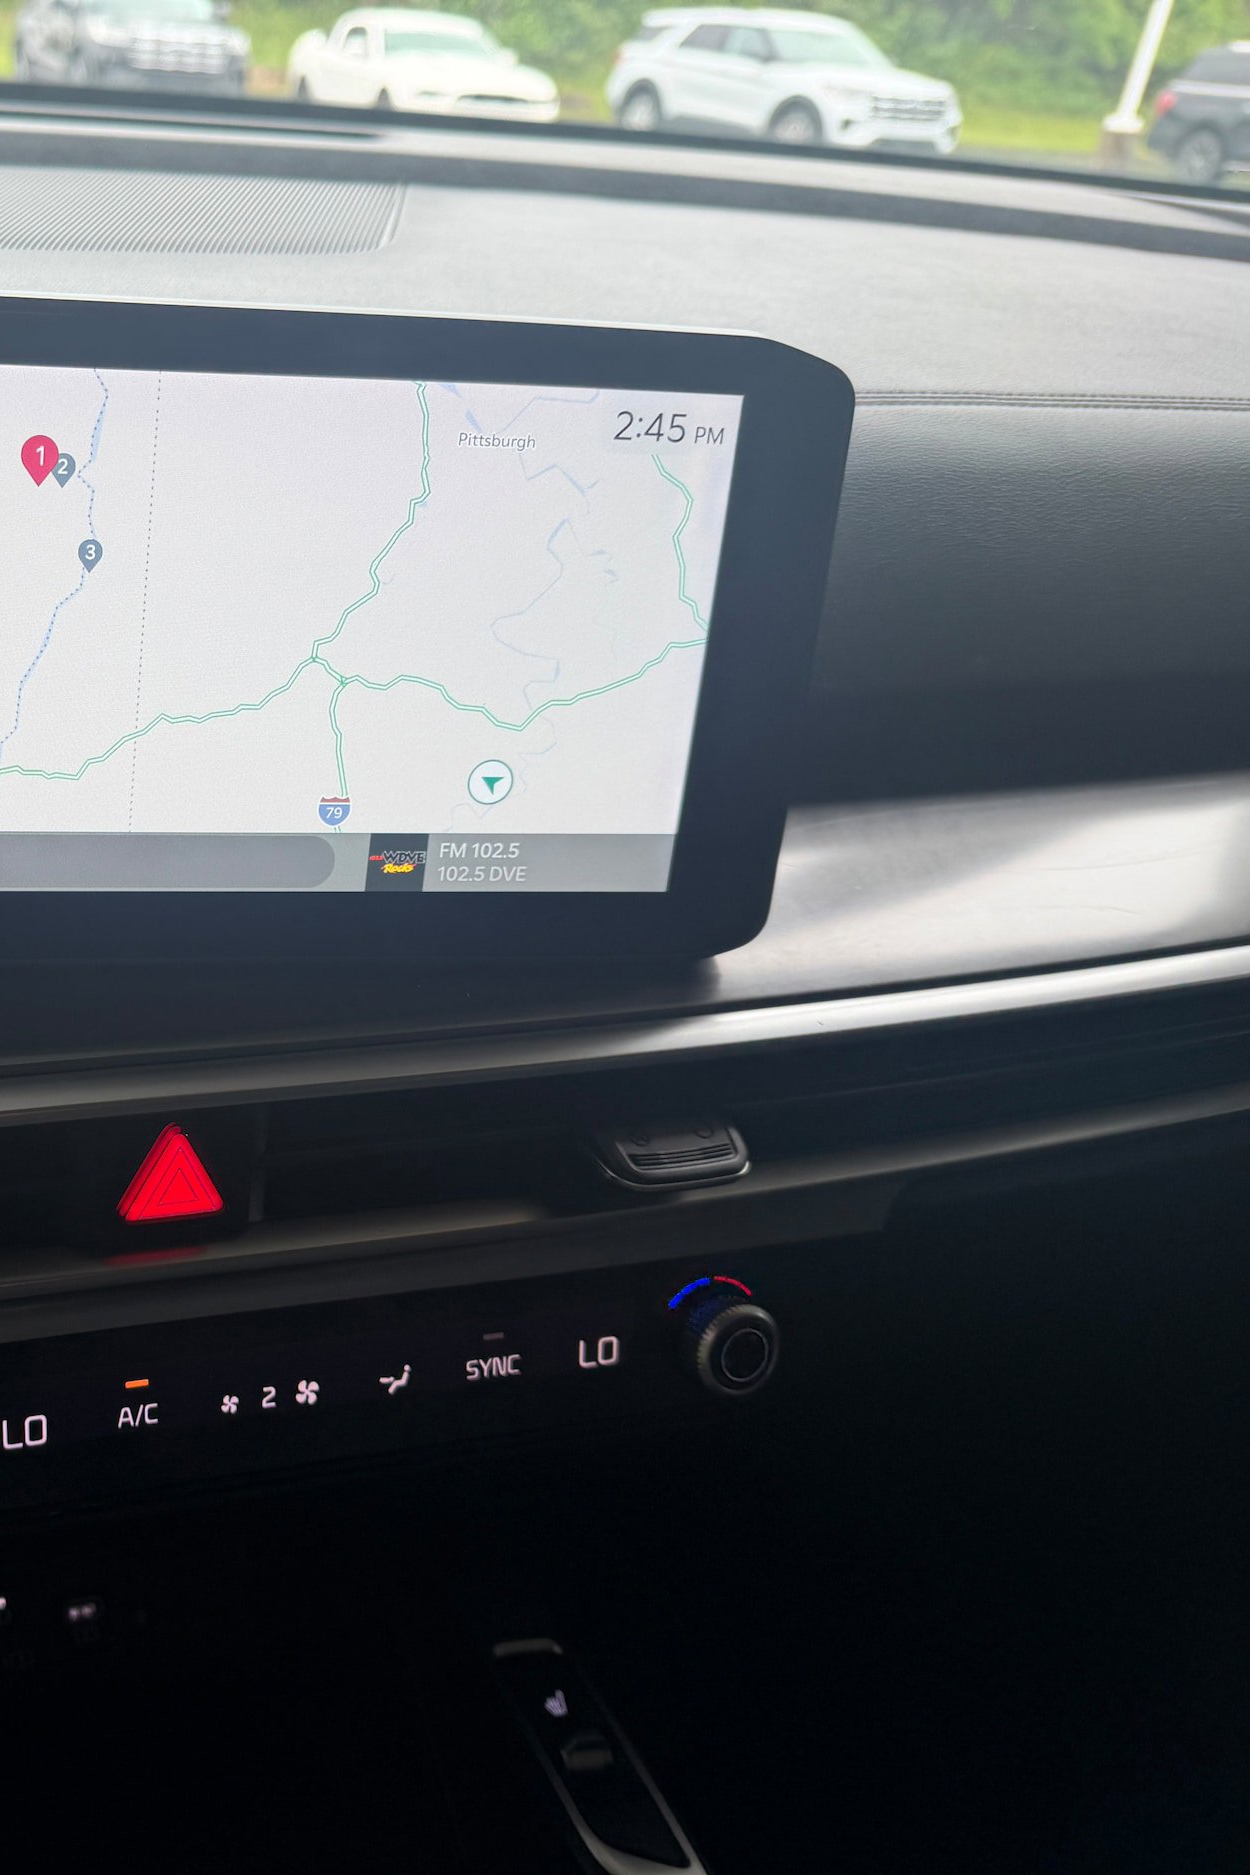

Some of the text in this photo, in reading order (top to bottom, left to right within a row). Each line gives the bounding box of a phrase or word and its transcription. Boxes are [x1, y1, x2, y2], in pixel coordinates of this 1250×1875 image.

[613, 410, 725, 445] 2:45 PM
[457, 432, 537, 451] Pittsburgh
[35, 445, 46, 466] 1
[58, 458, 69, 475] 2
[85, 544, 96, 561] 3
[325, 807, 343, 819] 79
[382, 850, 427, 864] WDVE
[439, 842, 521, 859] FM 102.5
[437, 866, 528, 882] 102.5 DVE
[578, 1335, 621, 1369] LO
[466, 1353, 523, 1381] SYNC
[262, 1386, 277, 1409] 2
[117, 1402, 159, 1430] A/C
[2, 1414, 48, 1451] LO
